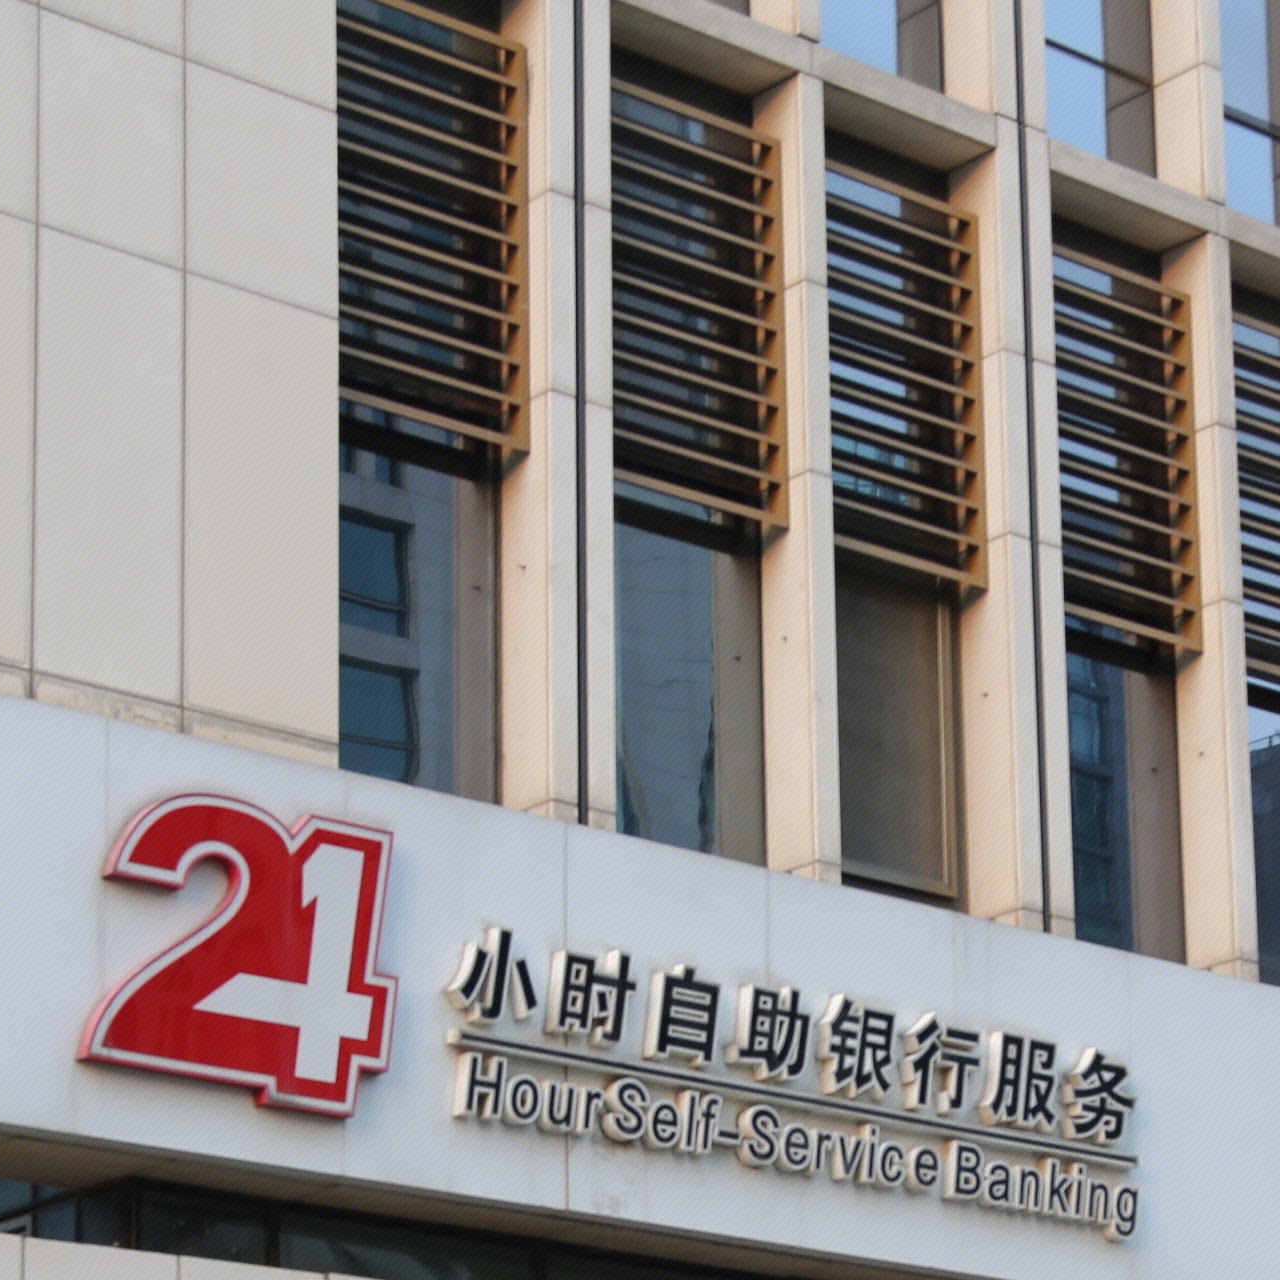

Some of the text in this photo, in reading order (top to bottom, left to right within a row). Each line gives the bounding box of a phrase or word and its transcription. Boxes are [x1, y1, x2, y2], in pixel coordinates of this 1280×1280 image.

[77, 793, 399, 1117] 24
[456, 928, 1135, 1140] 小时自助银行服务
[466, 1054, 1138, 1238] Hour Self-Service Banking
